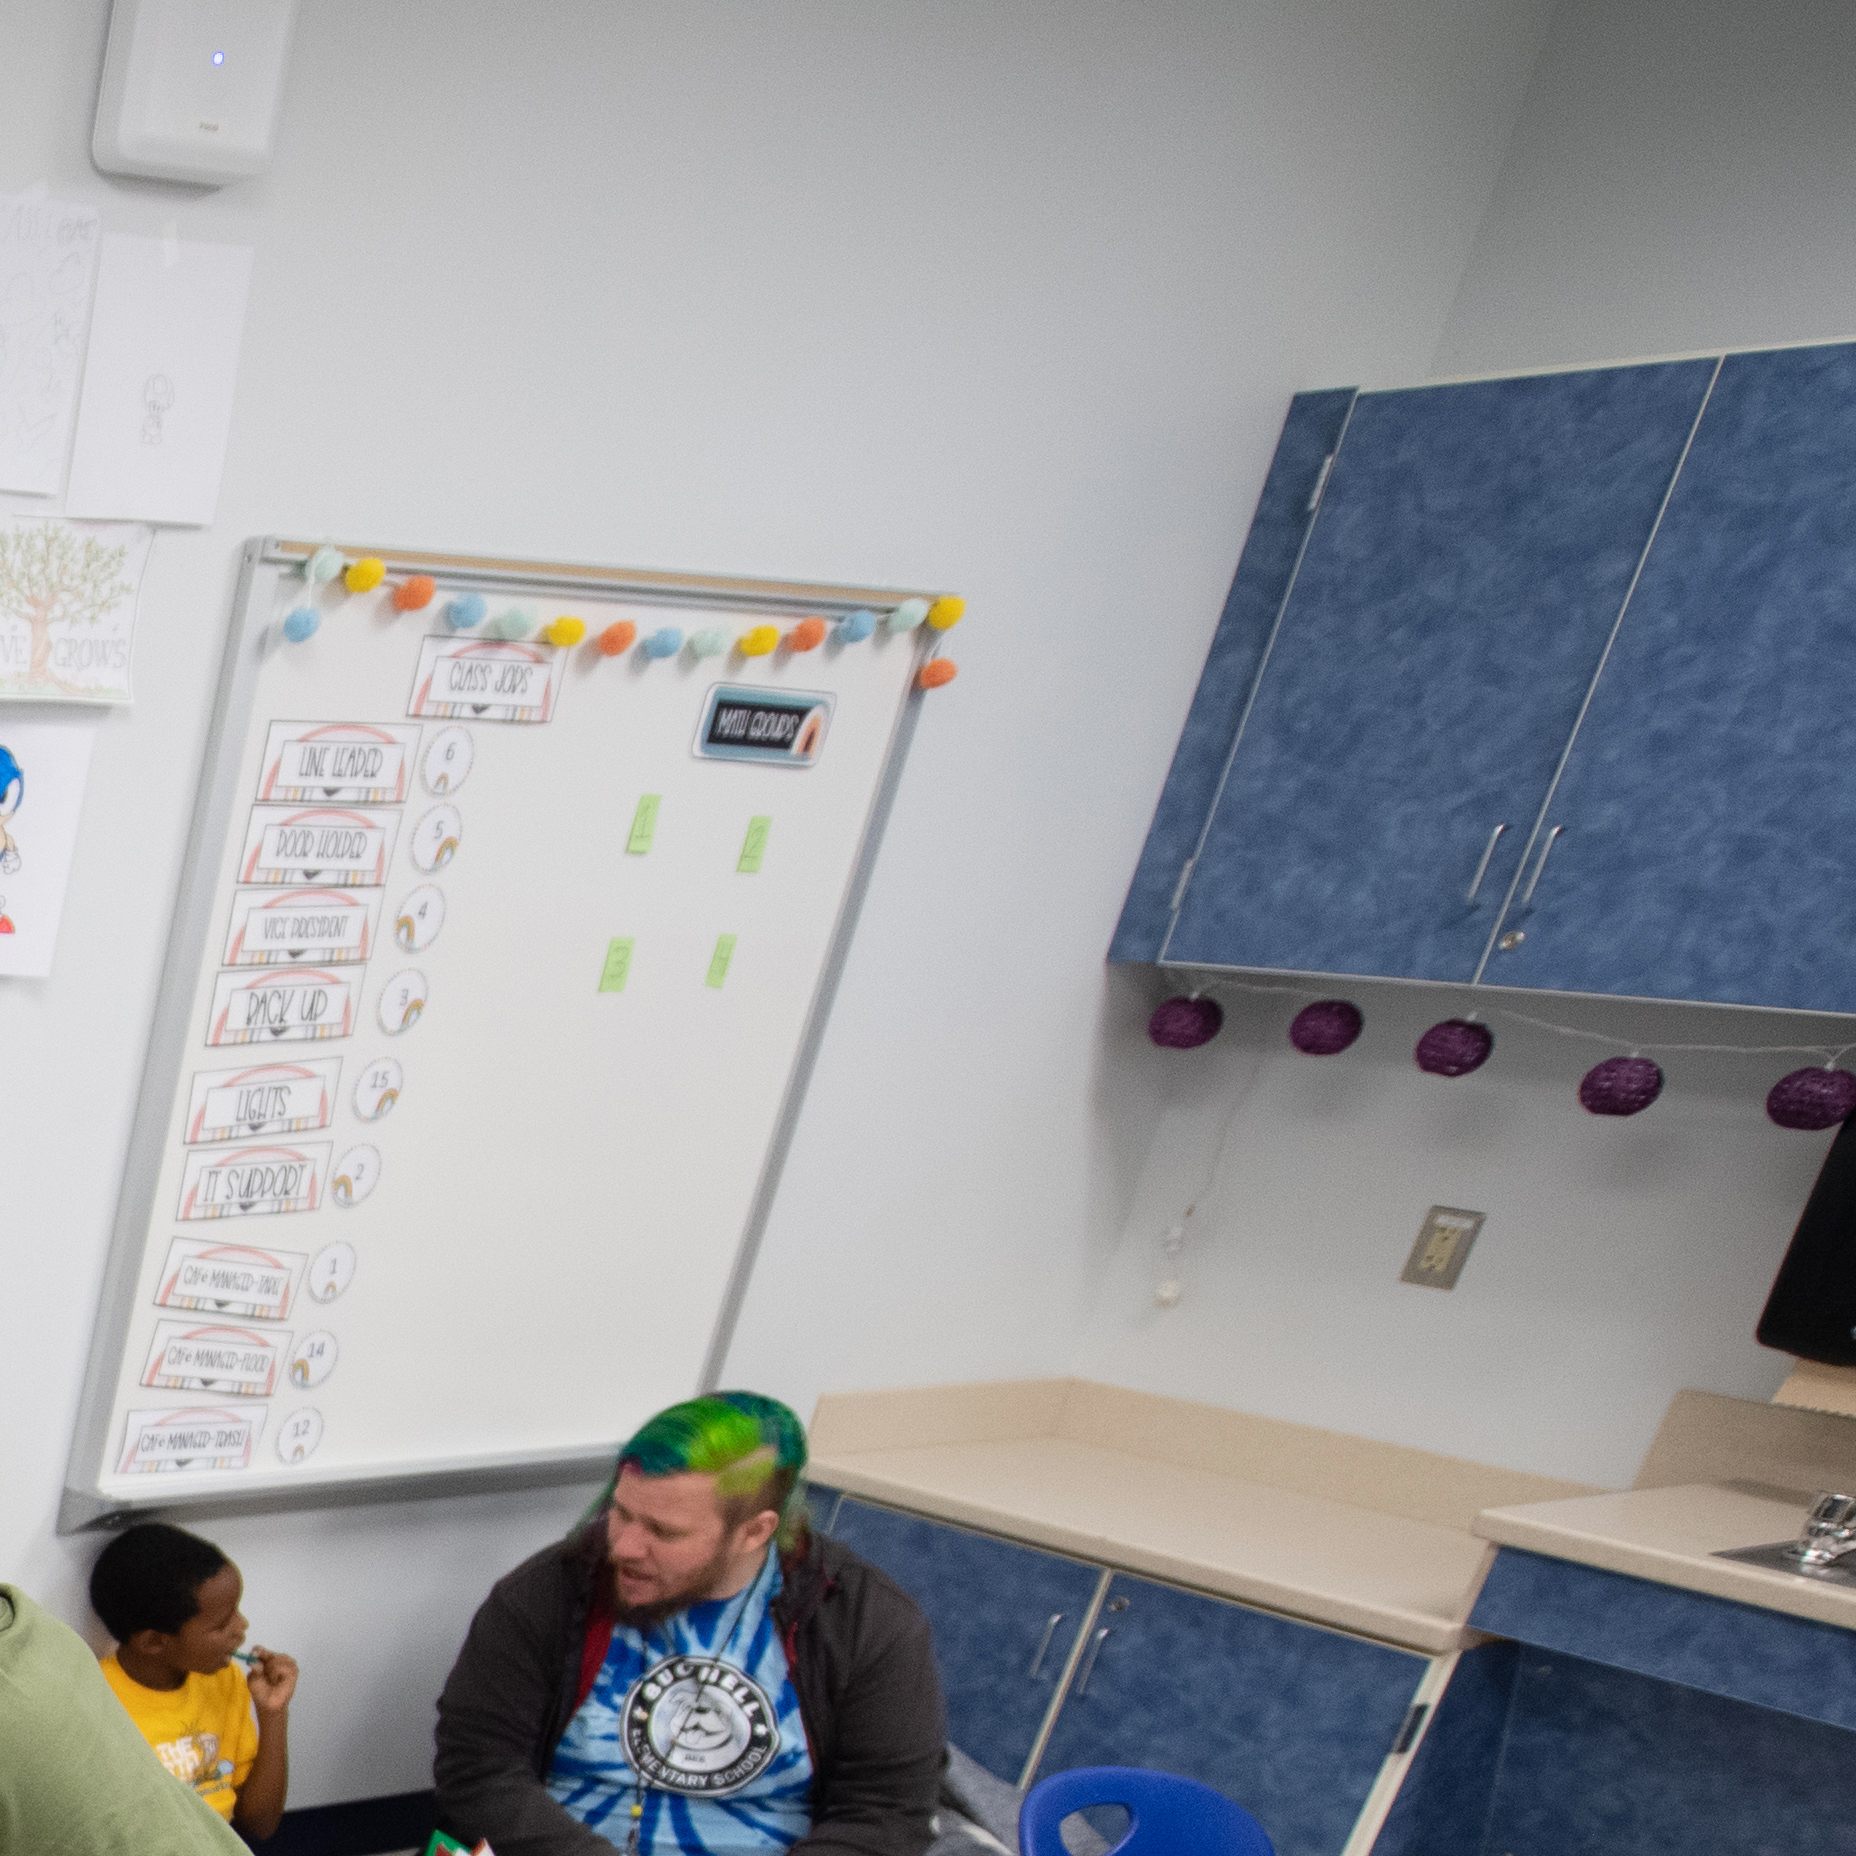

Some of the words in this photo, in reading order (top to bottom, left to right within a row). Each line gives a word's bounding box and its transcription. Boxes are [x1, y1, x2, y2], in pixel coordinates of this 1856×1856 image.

[445, 742, 457, 761] 6
[299, 746, 330, 777] LINE
[434, 820, 444, 840] 5
[417, 901, 428, 921] 4
[369, 1071, 389, 1089] 15
[236, 1086, 292, 1122] LIGHTS
[354, 1164, 364, 1181] 2
[203, 1169, 222, 1202] IT
[225, 1163, 308, 1200] SUPPORT
[329, 1258, 338, 1275] 1
[307, 1342, 325, 1358] 14
[292, 1420, 310, 1437] 12
[712, 1744, 768, 1786] SCHOOL
